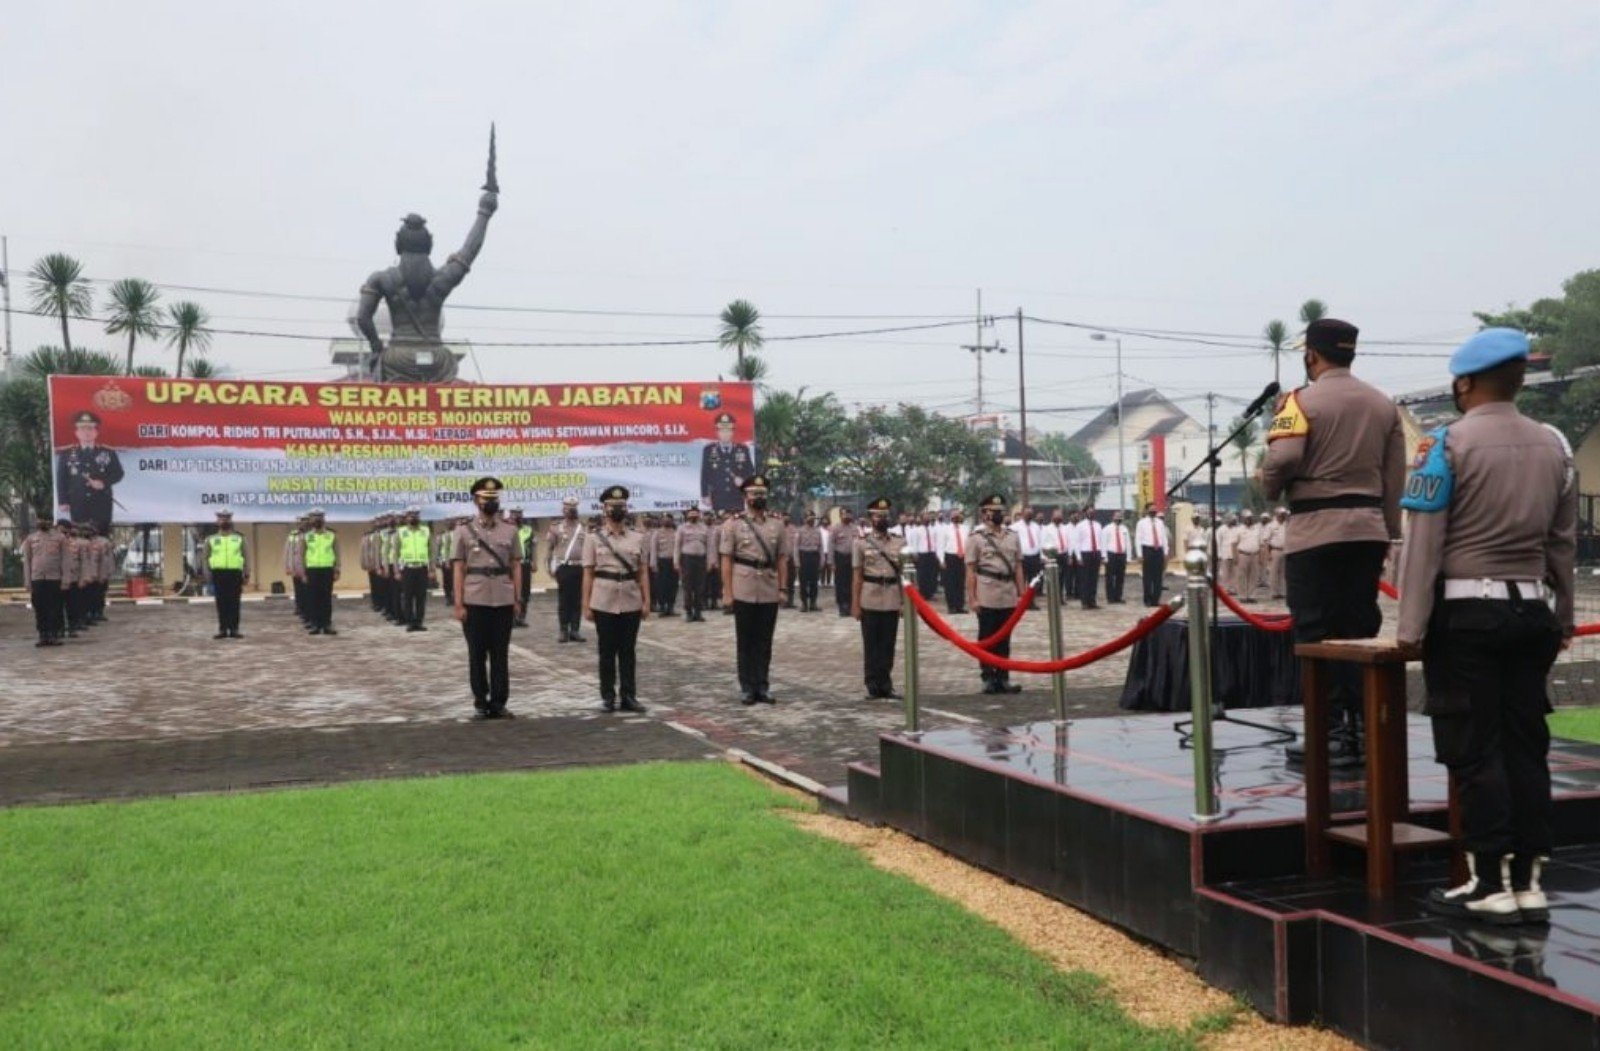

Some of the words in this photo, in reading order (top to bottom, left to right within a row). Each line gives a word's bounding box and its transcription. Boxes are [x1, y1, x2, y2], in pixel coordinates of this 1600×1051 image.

[146, 381, 310, 405] UPACARA
[317, 385, 427, 407] SERAH
[436, 386, 551, 407] TERIMA
[558, 385, 683, 407] JABATAN
[328, 410, 438, 426] WAKAPOLRES
[441, 410, 531, 426] MOJOKERTO
[138, 424, 169, 438] DARI
[170, 425, 221, 438] KOMPOL
[223, 426, 260, 439] RIDHO
[262, 427, 281, 439] TRI
[283, 427, 343, 441] PUTRANTO,
[432, 428, 476, 441] KEPADA
[476, 427, 519, 440] KOMPOL
[521, 426, 554, 439] WISNU
[285, 443, 338, 459] KASAT
[340, 444, 413, 459] RESKRIM
[416, 444, 477, 459] POLRES
[481, 441, 569, 458] MOJOKERTO
[138, 458, 167, 471] DARI
[434, 460, 475, 471] KEPADA
[268, 475, 320, 492] KASAT
[323, 476, 430, 492] RESNARKOBA
[435, 475, 478, 491] POLR
[501, 472, 588, 490] MOJOKERTO
[200, 492, 230, 505] DARI
